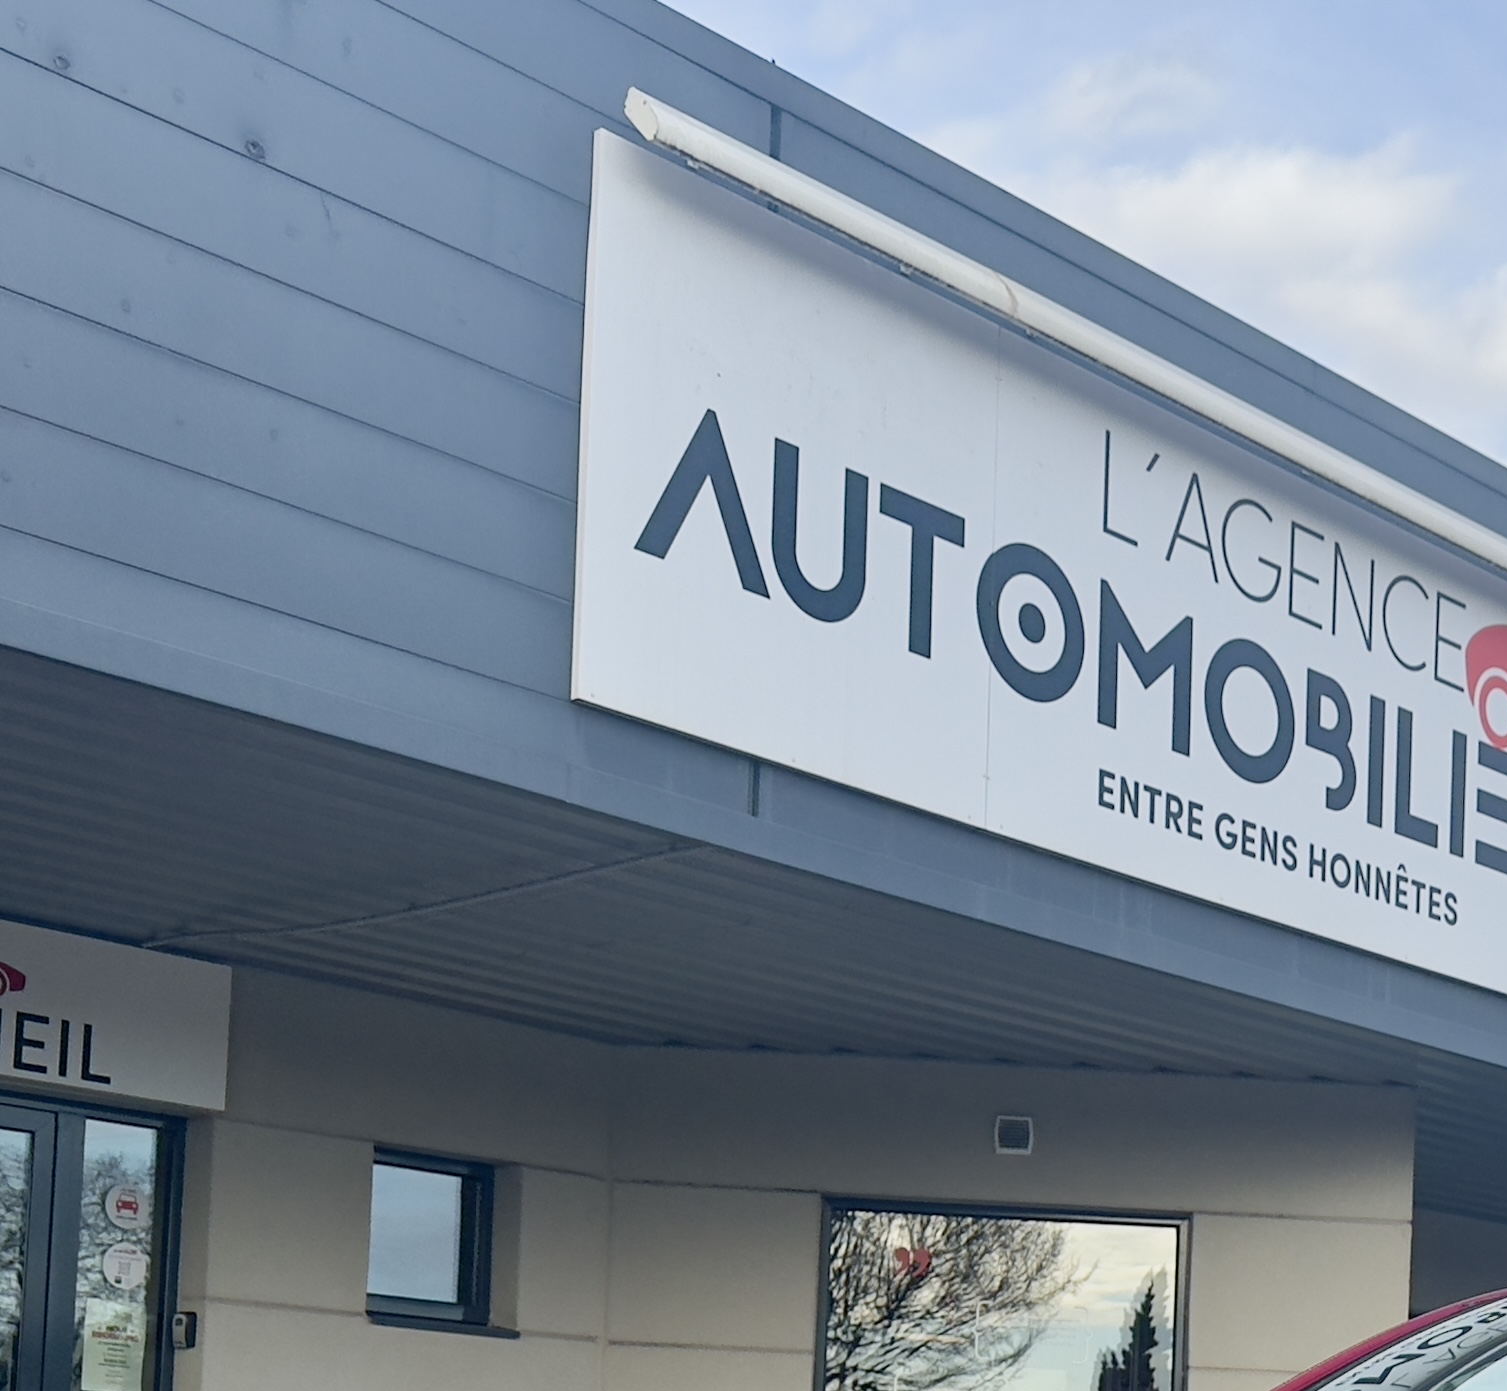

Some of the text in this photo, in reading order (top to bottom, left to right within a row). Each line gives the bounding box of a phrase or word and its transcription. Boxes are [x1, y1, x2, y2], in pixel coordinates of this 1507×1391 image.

[1102, 429, 1467, 692] L'AGENCE
[1098, 768, 1459, 926] ENTRE GENS HONNÊTES
[0, 1005, 111, 1085] EIL
